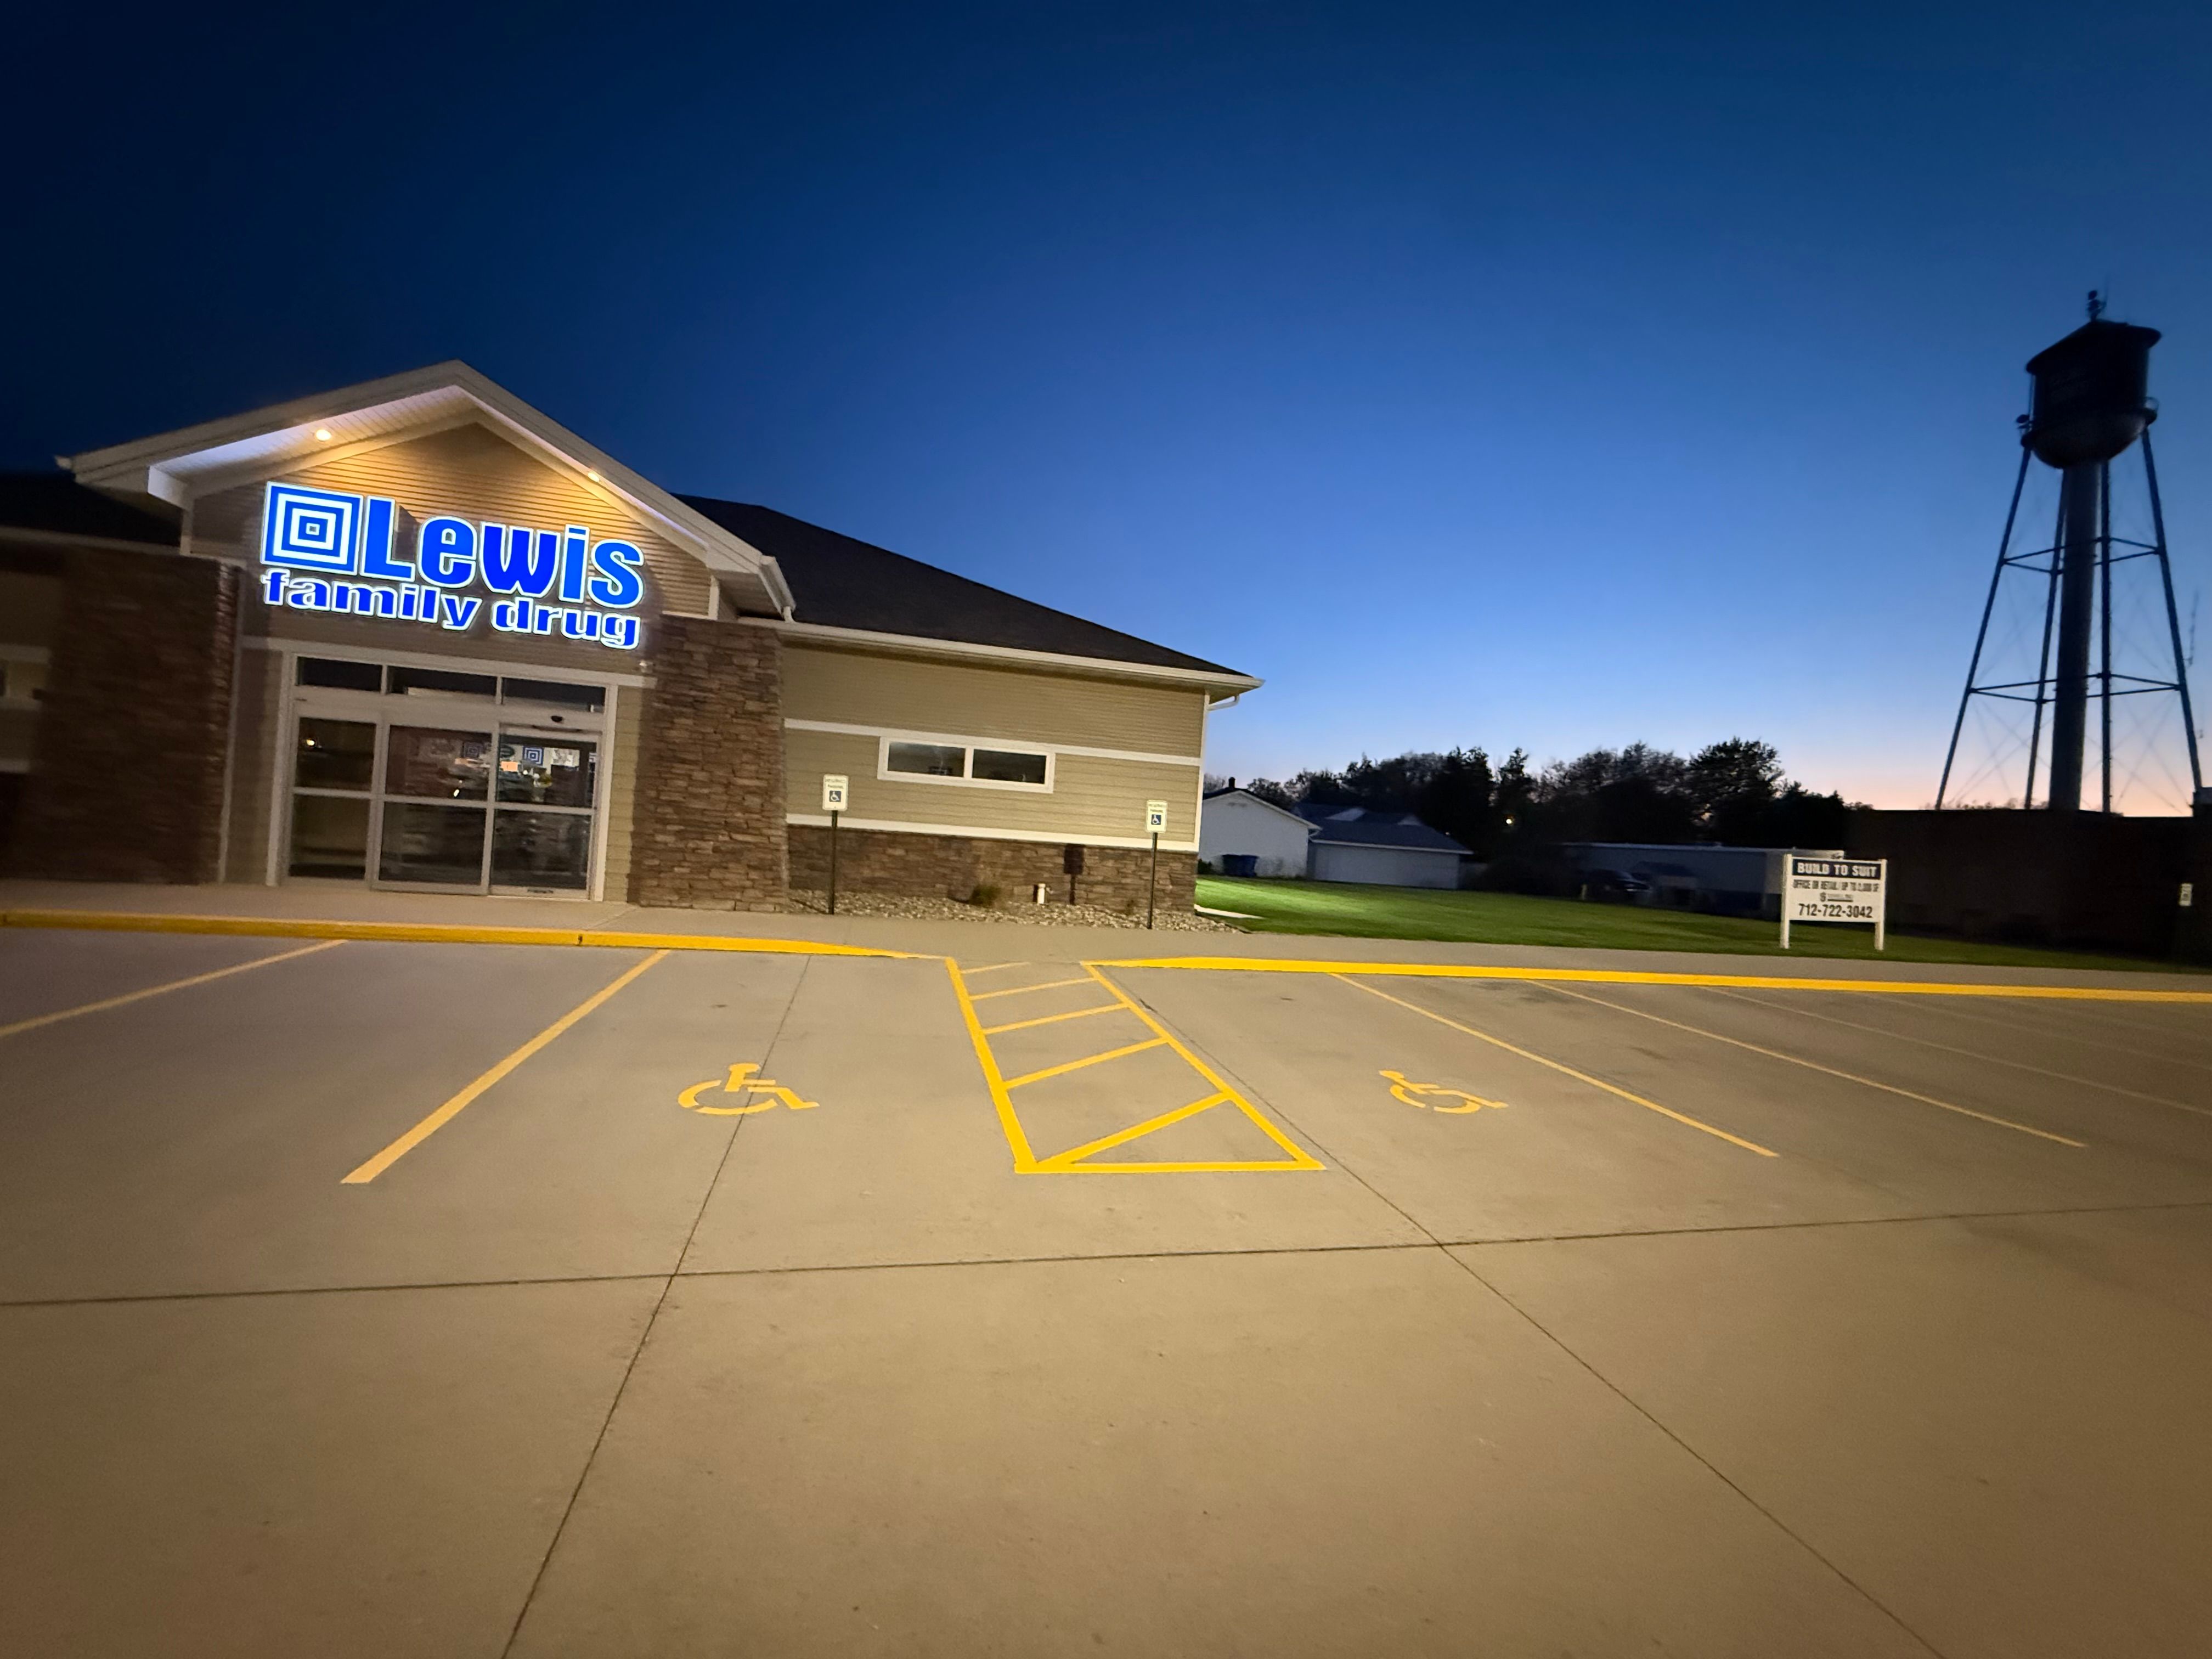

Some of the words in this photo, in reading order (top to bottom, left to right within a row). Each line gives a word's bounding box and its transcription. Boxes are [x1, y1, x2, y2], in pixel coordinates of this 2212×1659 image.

[360, 494, 645, 610] Lewis
[262, 568, 482, 631] family
[492, 597, 641, 651] drug
[1797, 862, 1829, 874] BUILD
[1834, 865, 1848, 876] TO
[1852, 866, 1877, 877] SUIT
[1799, 904, 1872, 918] 712-722-3042
